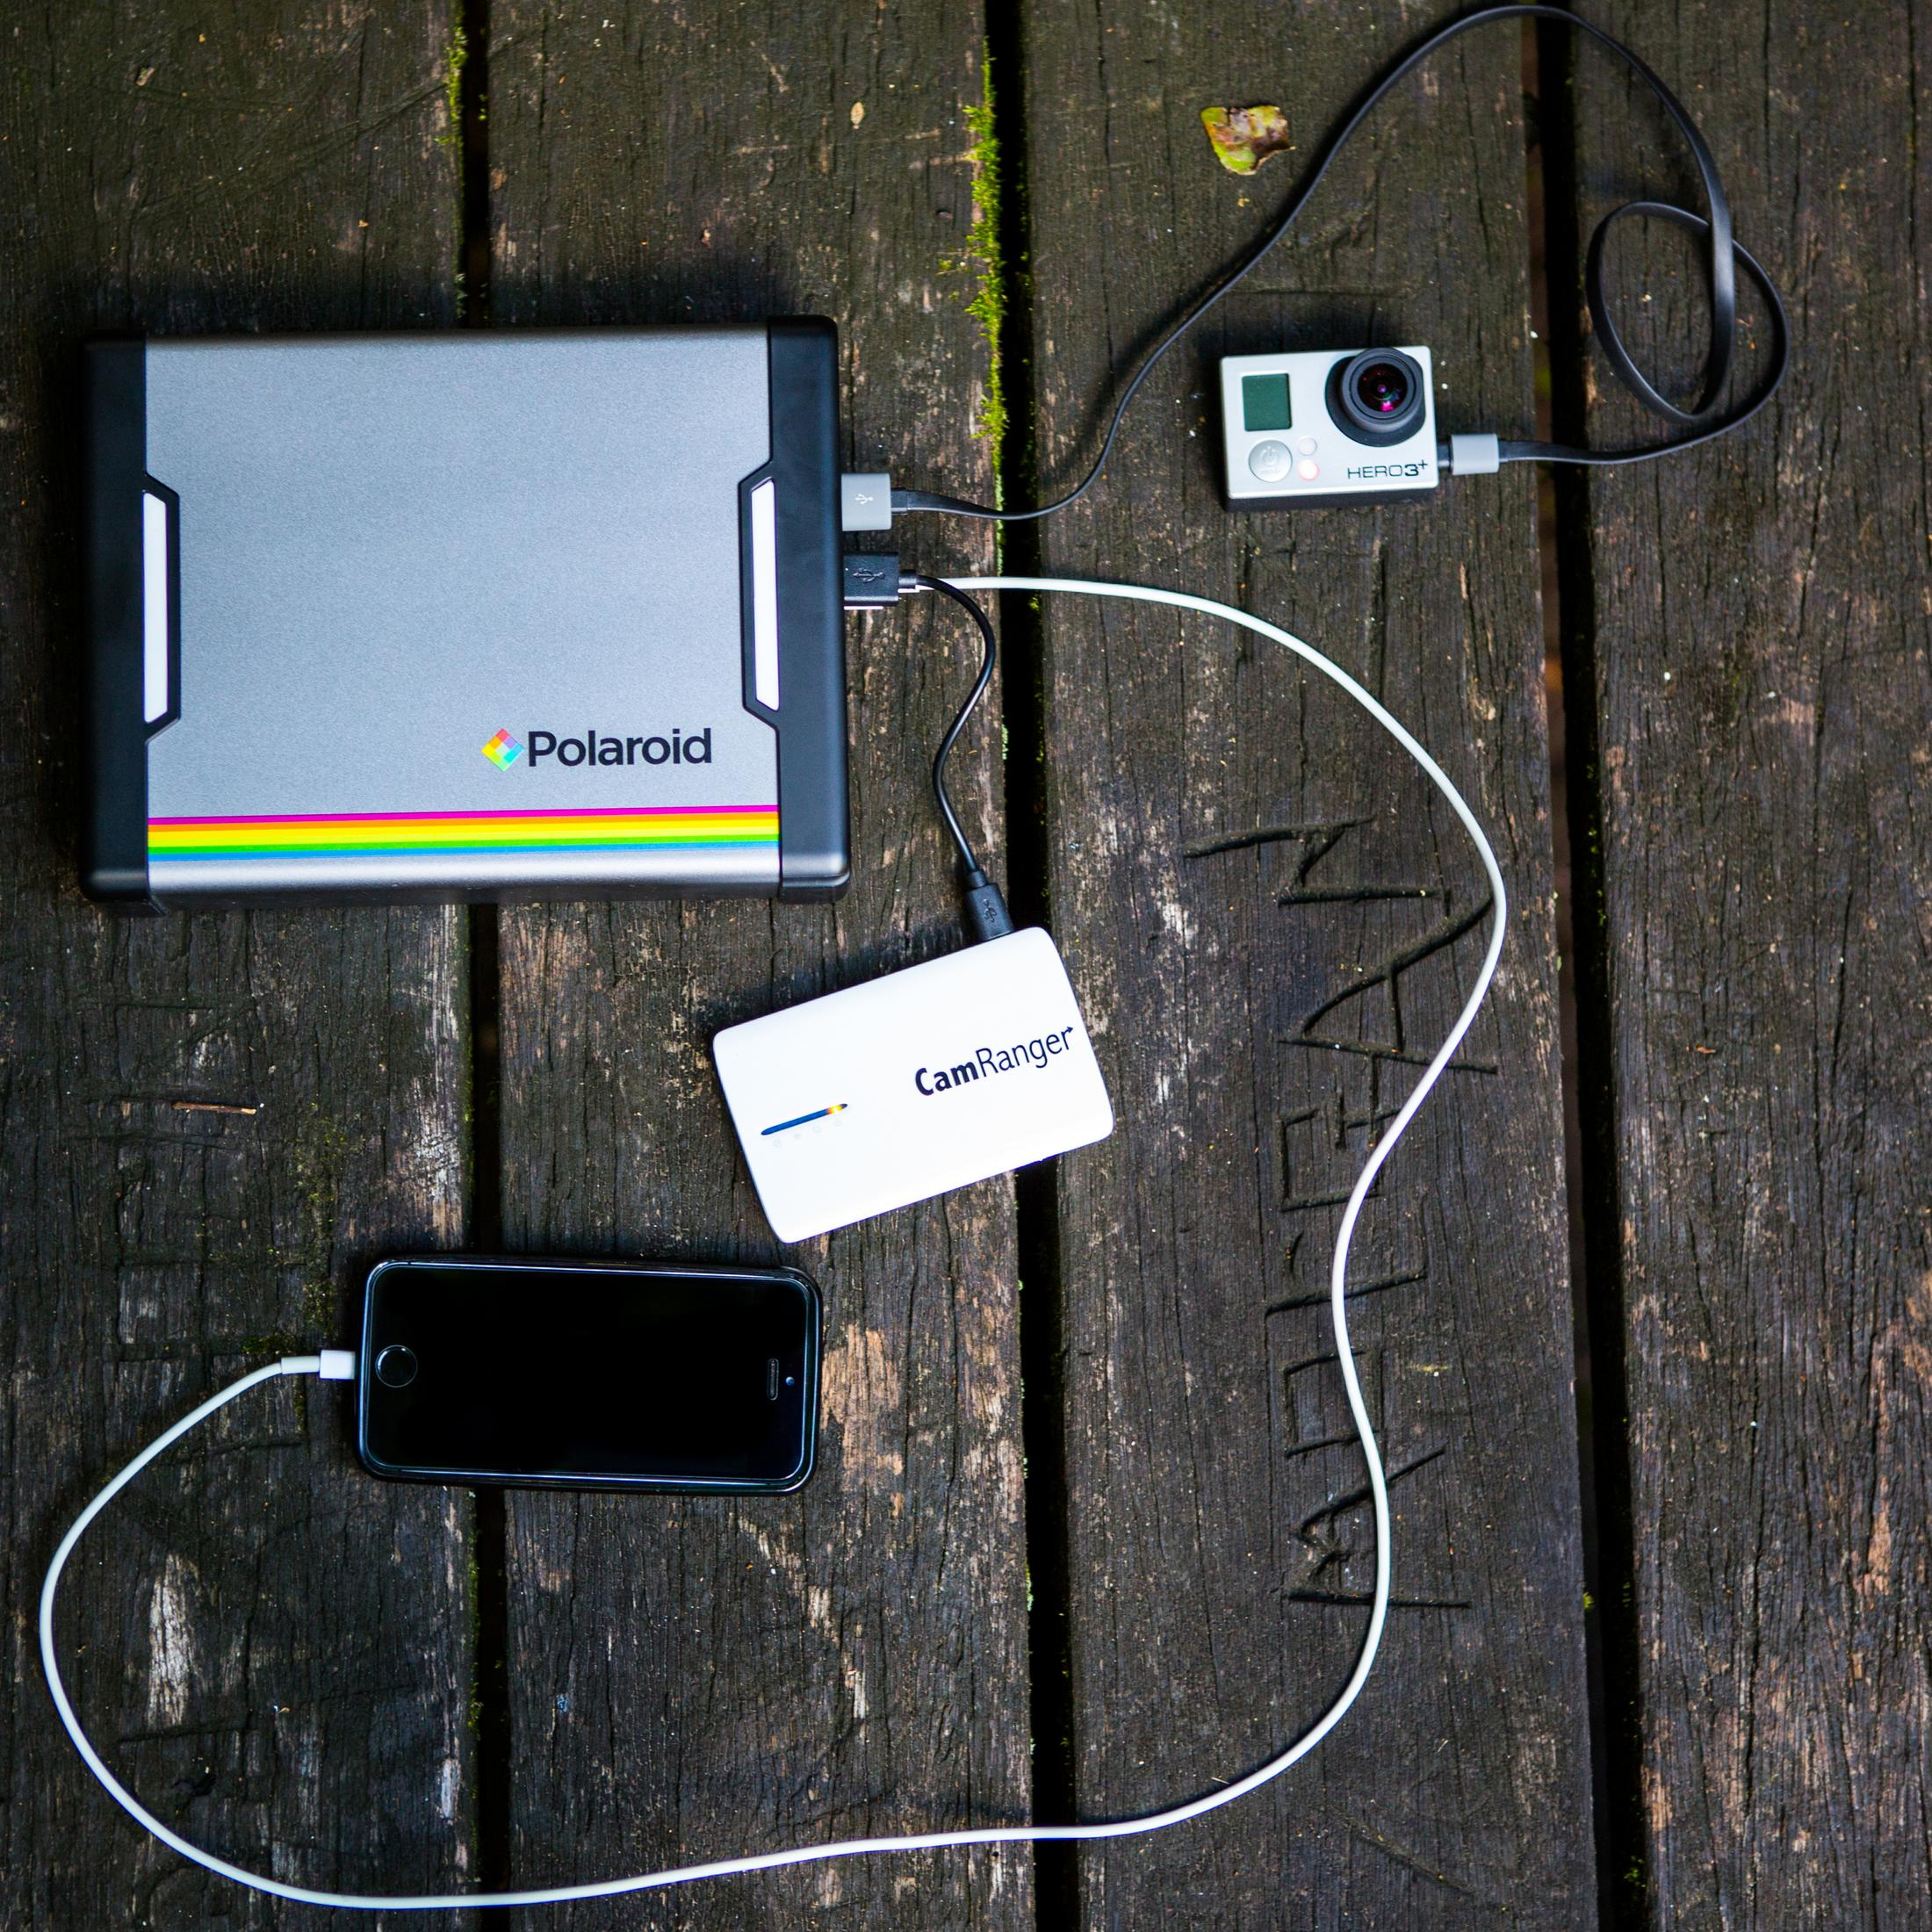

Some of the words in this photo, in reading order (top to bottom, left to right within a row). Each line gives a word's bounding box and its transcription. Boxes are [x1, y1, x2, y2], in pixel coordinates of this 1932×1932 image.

[1347, 459, 1429, 479] HERO3+
[528, 728, 712, 768] Polaroid
[915, 1026, 1074, 1096] CamRanger
